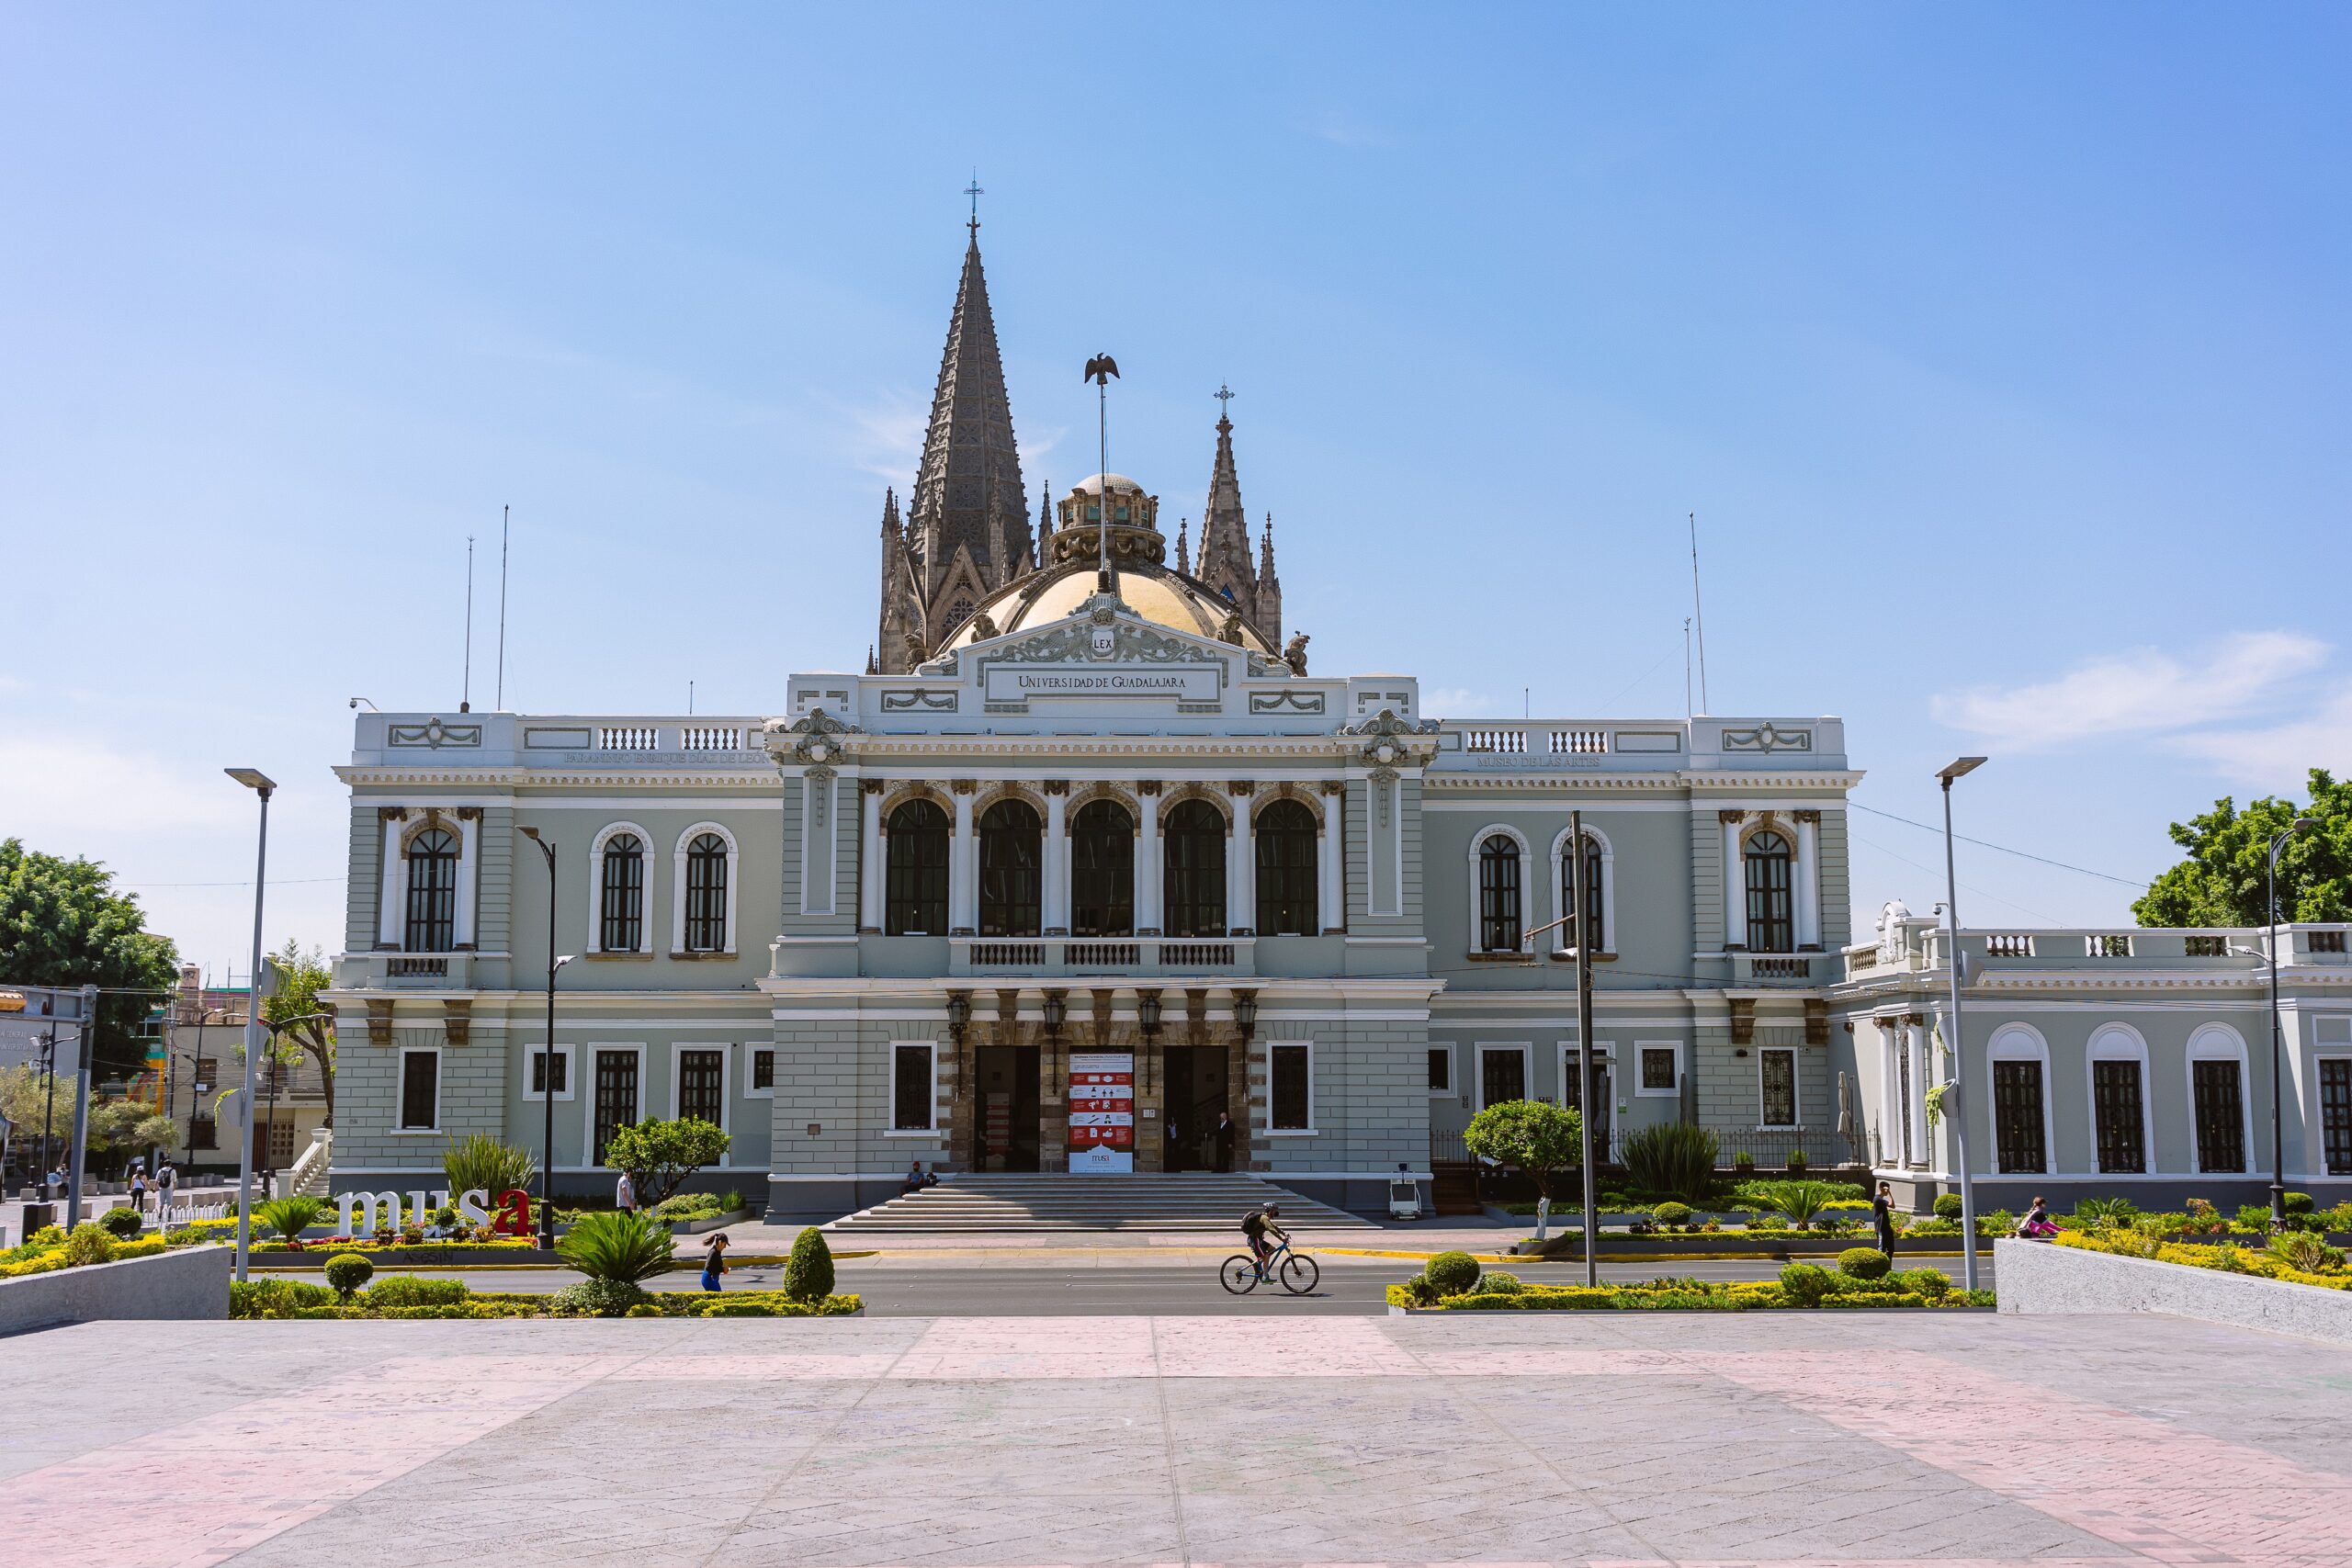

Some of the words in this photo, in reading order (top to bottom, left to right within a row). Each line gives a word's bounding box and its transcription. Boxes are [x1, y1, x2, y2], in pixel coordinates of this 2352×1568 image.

[1093, 638, 1113, 649] LEX
[1018, 675, 1094, 688] UNIVERSIDAD
[1095, 677, 1109, 688] DE
[1111, 675, 1186, 688] GUADALAJARA
[565, 752, 631, 763] PARANINFO
[634, 752, 686, 765] ENRIQUE
[719, 752, 736, 763] DE
[1476, 756, 1519, 767] MUSEO
[1521, 756, 1537, 767] DE
[1538, 756, 1562, 767] LAS
[1564, 756, 1601, 767] ARTES
[333, 1189, 535, 1239] musa
